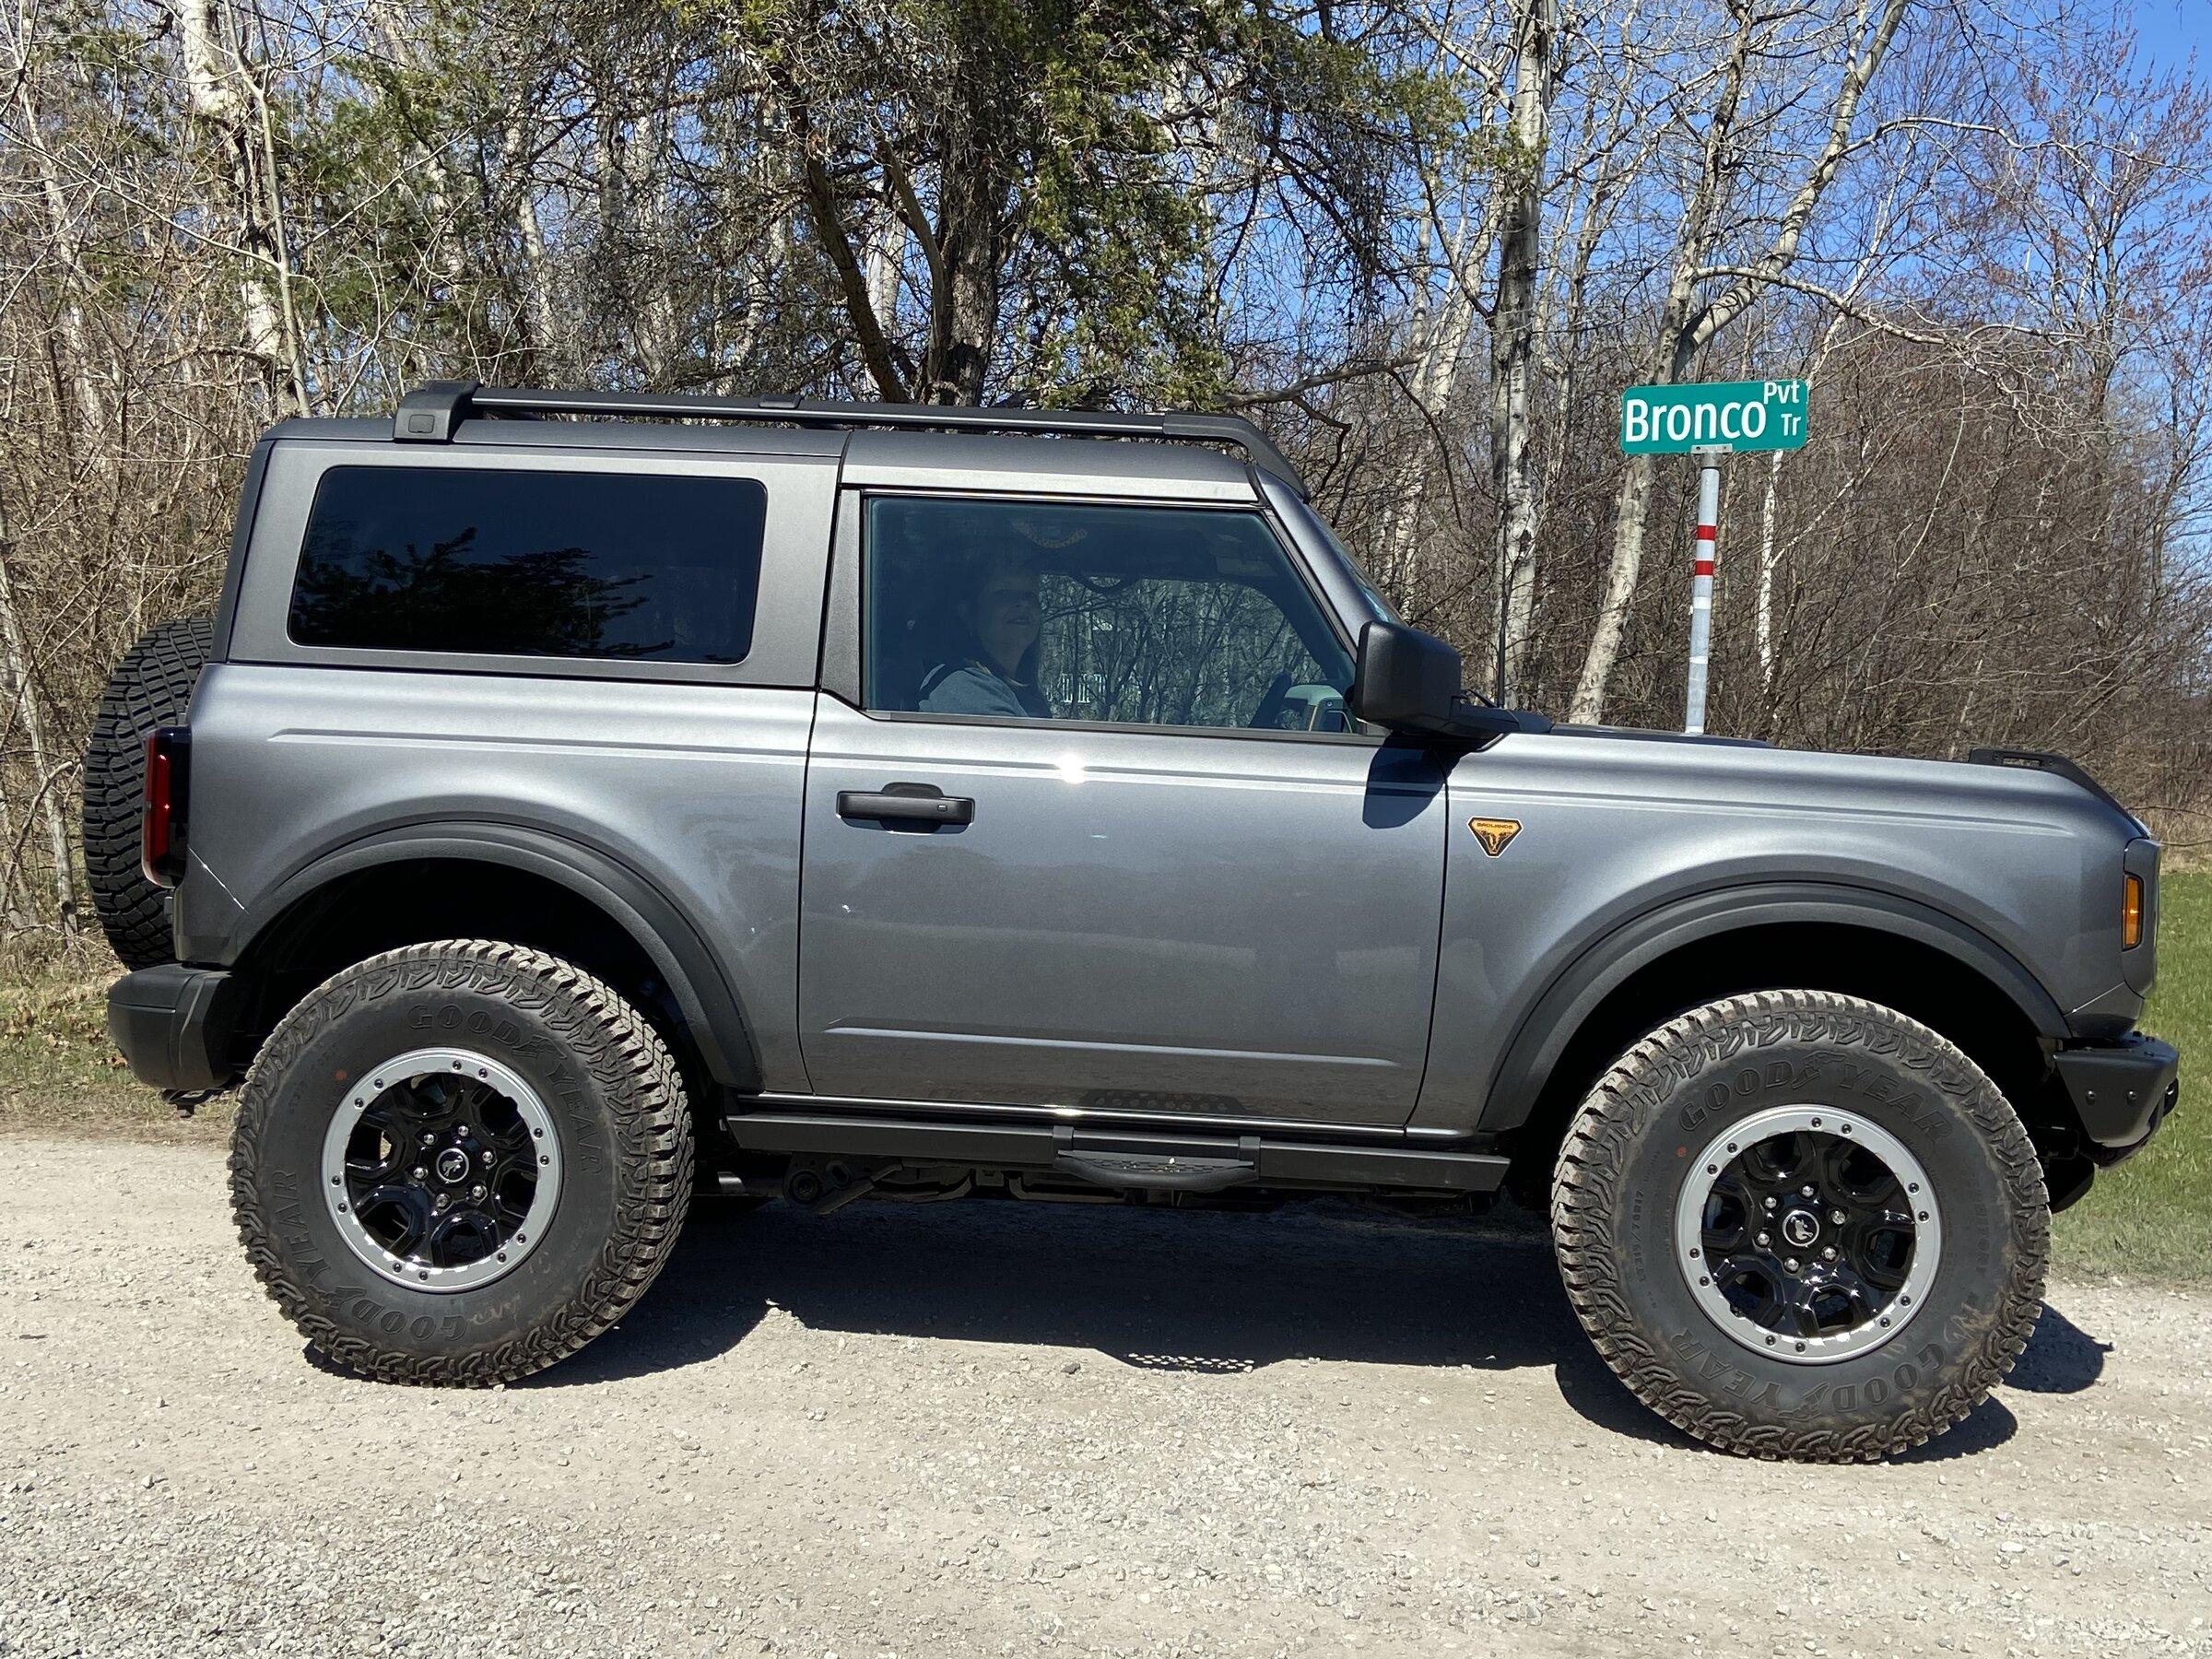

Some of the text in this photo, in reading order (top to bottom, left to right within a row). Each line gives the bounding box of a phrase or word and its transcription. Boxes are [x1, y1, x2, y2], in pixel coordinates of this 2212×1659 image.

[1763, 381, 1800, 404] Pvt
[1626, 399, 1802, 442] Bronco Tr
